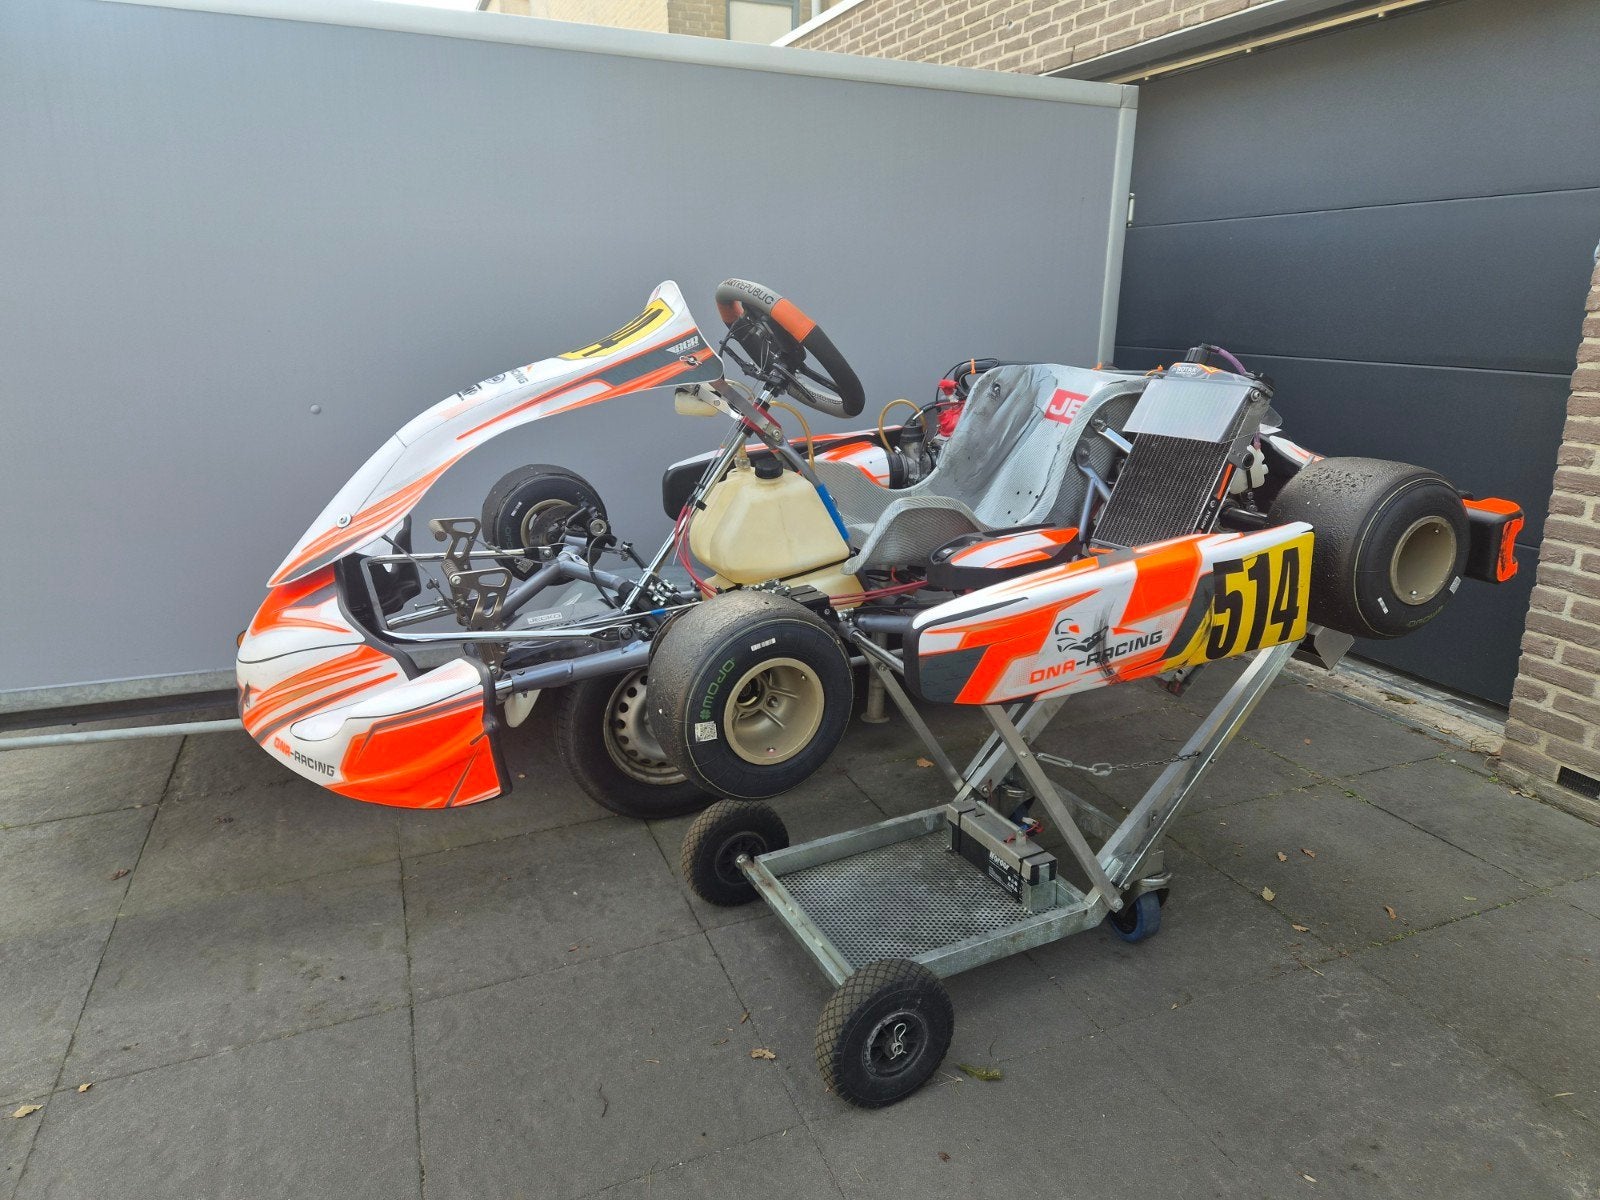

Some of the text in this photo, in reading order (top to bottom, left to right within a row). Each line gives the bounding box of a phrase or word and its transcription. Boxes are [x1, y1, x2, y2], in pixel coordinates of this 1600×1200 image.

[1206, 547, 1300, 660] 514
[1029, 630, 1163, 684] DNA-RACING
[273, 736, 335, 777] DNA-RACING
